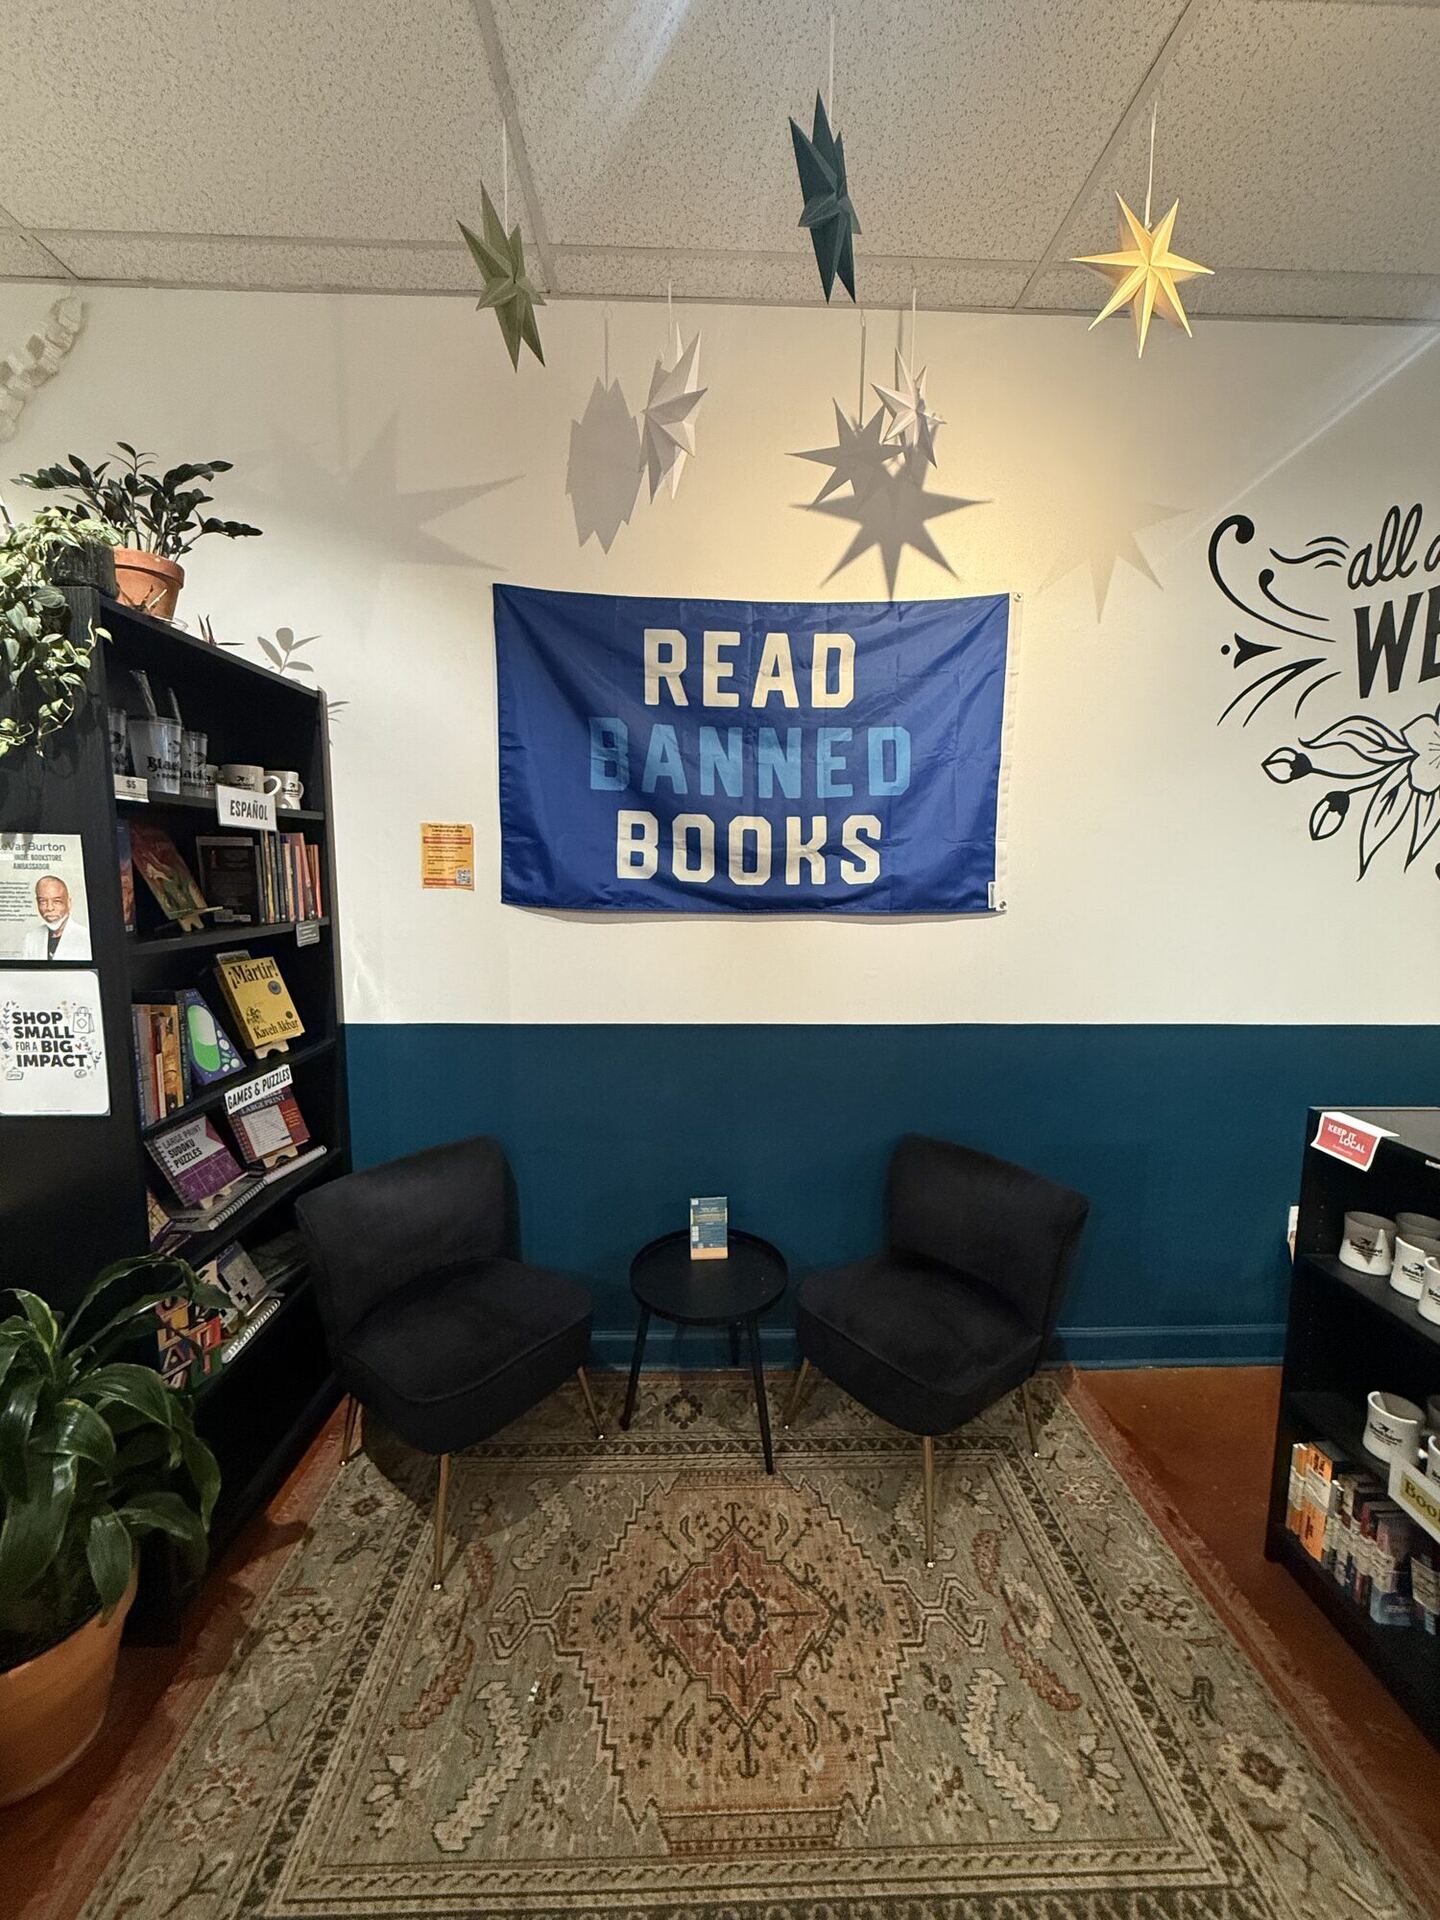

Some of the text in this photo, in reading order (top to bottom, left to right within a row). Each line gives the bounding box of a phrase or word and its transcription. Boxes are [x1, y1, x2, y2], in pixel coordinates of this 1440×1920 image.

[1347, 503, 1423, 590] all
[643, 628, 857, 708] READ
[589, 717, 911, 798] BANNED
[230, 800, 268, 821] ESPAÑOL
[28, 843, 66, 852] Burton
[617, 810, 882, 885] BOOKS
[12, 1012, 63, 1024] SHOP
[14, 1026, 75, 1039] SMALL
[16, 1040, 73, 1053] FOR A BIG
[16, 1055, 87, 1067] IMPACT
[227, 1086, 253, 1109] GAMES
[254, 1082, 260, 1096] &
[262, 1068, 290, 1092] PUZZLES
[1327, 1124, 1357, 1141] KEEP IT
[168, 1139, 195, 1158] SUDOKU
[1339, 1135, 1366, 1153] LOCAL
[173, 1147, 202, 1168] PUZZLES
